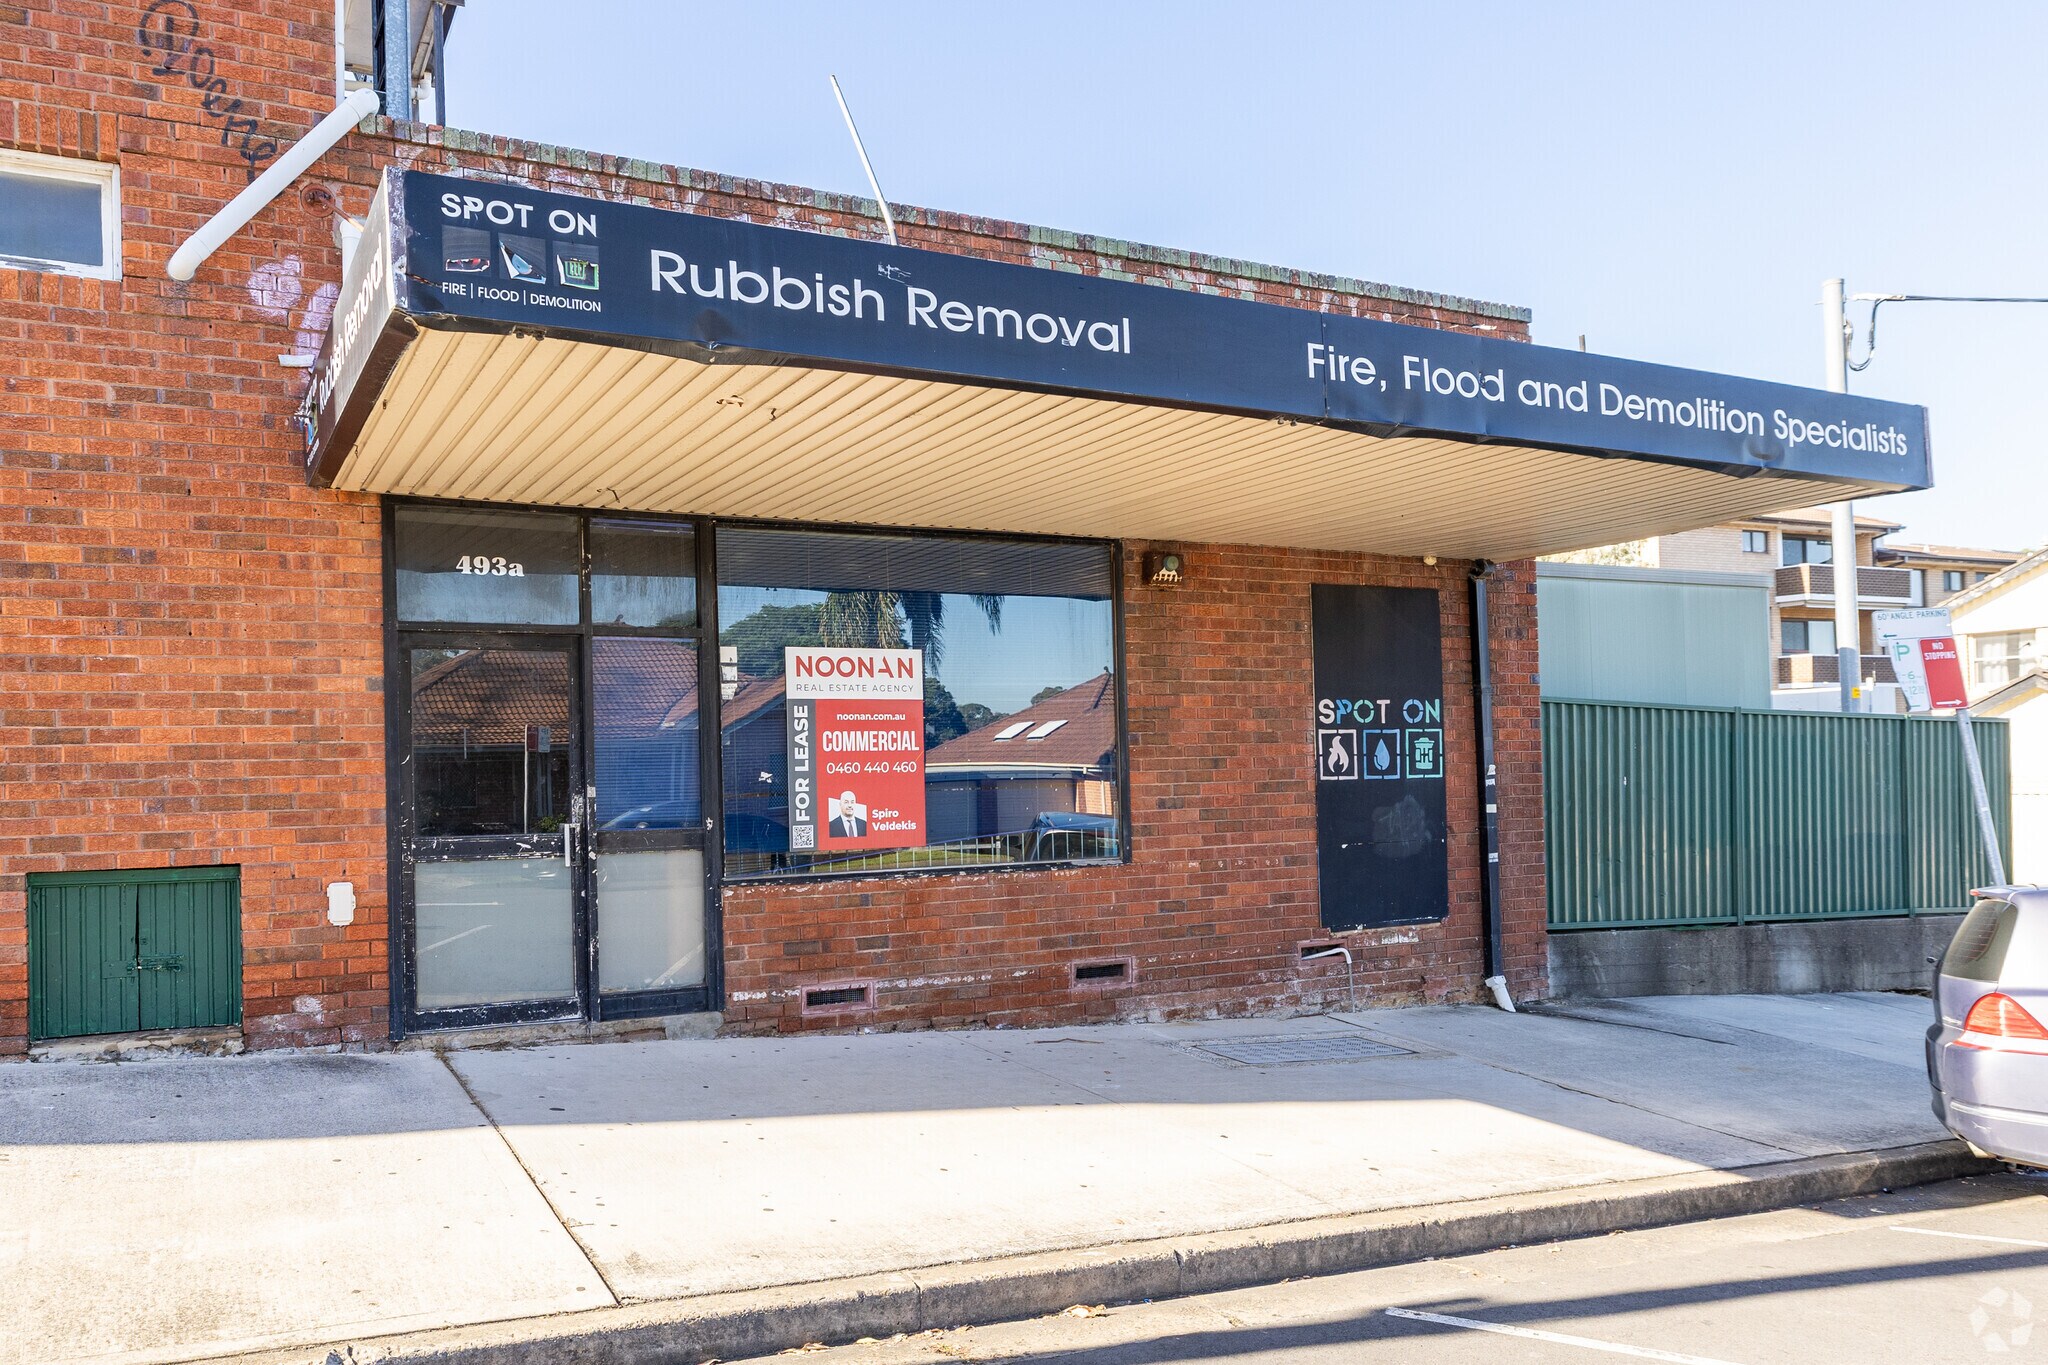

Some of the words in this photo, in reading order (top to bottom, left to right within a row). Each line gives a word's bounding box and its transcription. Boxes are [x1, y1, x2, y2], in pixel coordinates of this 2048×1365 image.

[441, 193, 534, 228] SPOT
[548, 209, 597, 237] ON
[344, 233, 384, 352] Removal
[442, 282, 466, 296] FIRE
[478, 286, 519, 302] FLOOD
[530, 293, 601, 313] DEMOLITION
[650, 249, 885, 322] Rubbish
[907, 286, 1131, 354] Removal
[1307, 342, 1387, 393] Fire,
[1403, 355, 1505, 402] Flood
[1517, 380, 1589, 413] and
[1599, 382, 1765, 437] Demolition
[1773, 409, 1908, 456] Specialists
[455, 555, 525, 577] 493a
[1891, 611, 1914, 619] ANGLE
[1916, 609, 1948, 618] PARKING
[1894, 644, 1910, 661] P
[1924, 651, 1957, 660] STOPPING
[1931, 642, 1944, 650] NO
[795, 655, 914, 679] NOONAN
[796, 683, 824, 692] REAL
[828, 684, 868, 692] ESTATE
[872, 684, 914, 693] AGENCY
[836, 713, 906, 721] noonan.com.au
[1318, 698, 1391, 725] SPOT
[1402, 698, 1441, 724] ON
[793, 705, 810, 772] LEASE
[822, 730, 920, 752] COMMERCIAL
[826, 762, 861, 775] 0460
[864, 762, 889, 774] 440
[892, 761, 917, 774] 460
[795, 777, 811, 822] FOR
[871, 808, 899, 821] Spiro
[872, 820, 917, 831] Veldekis
